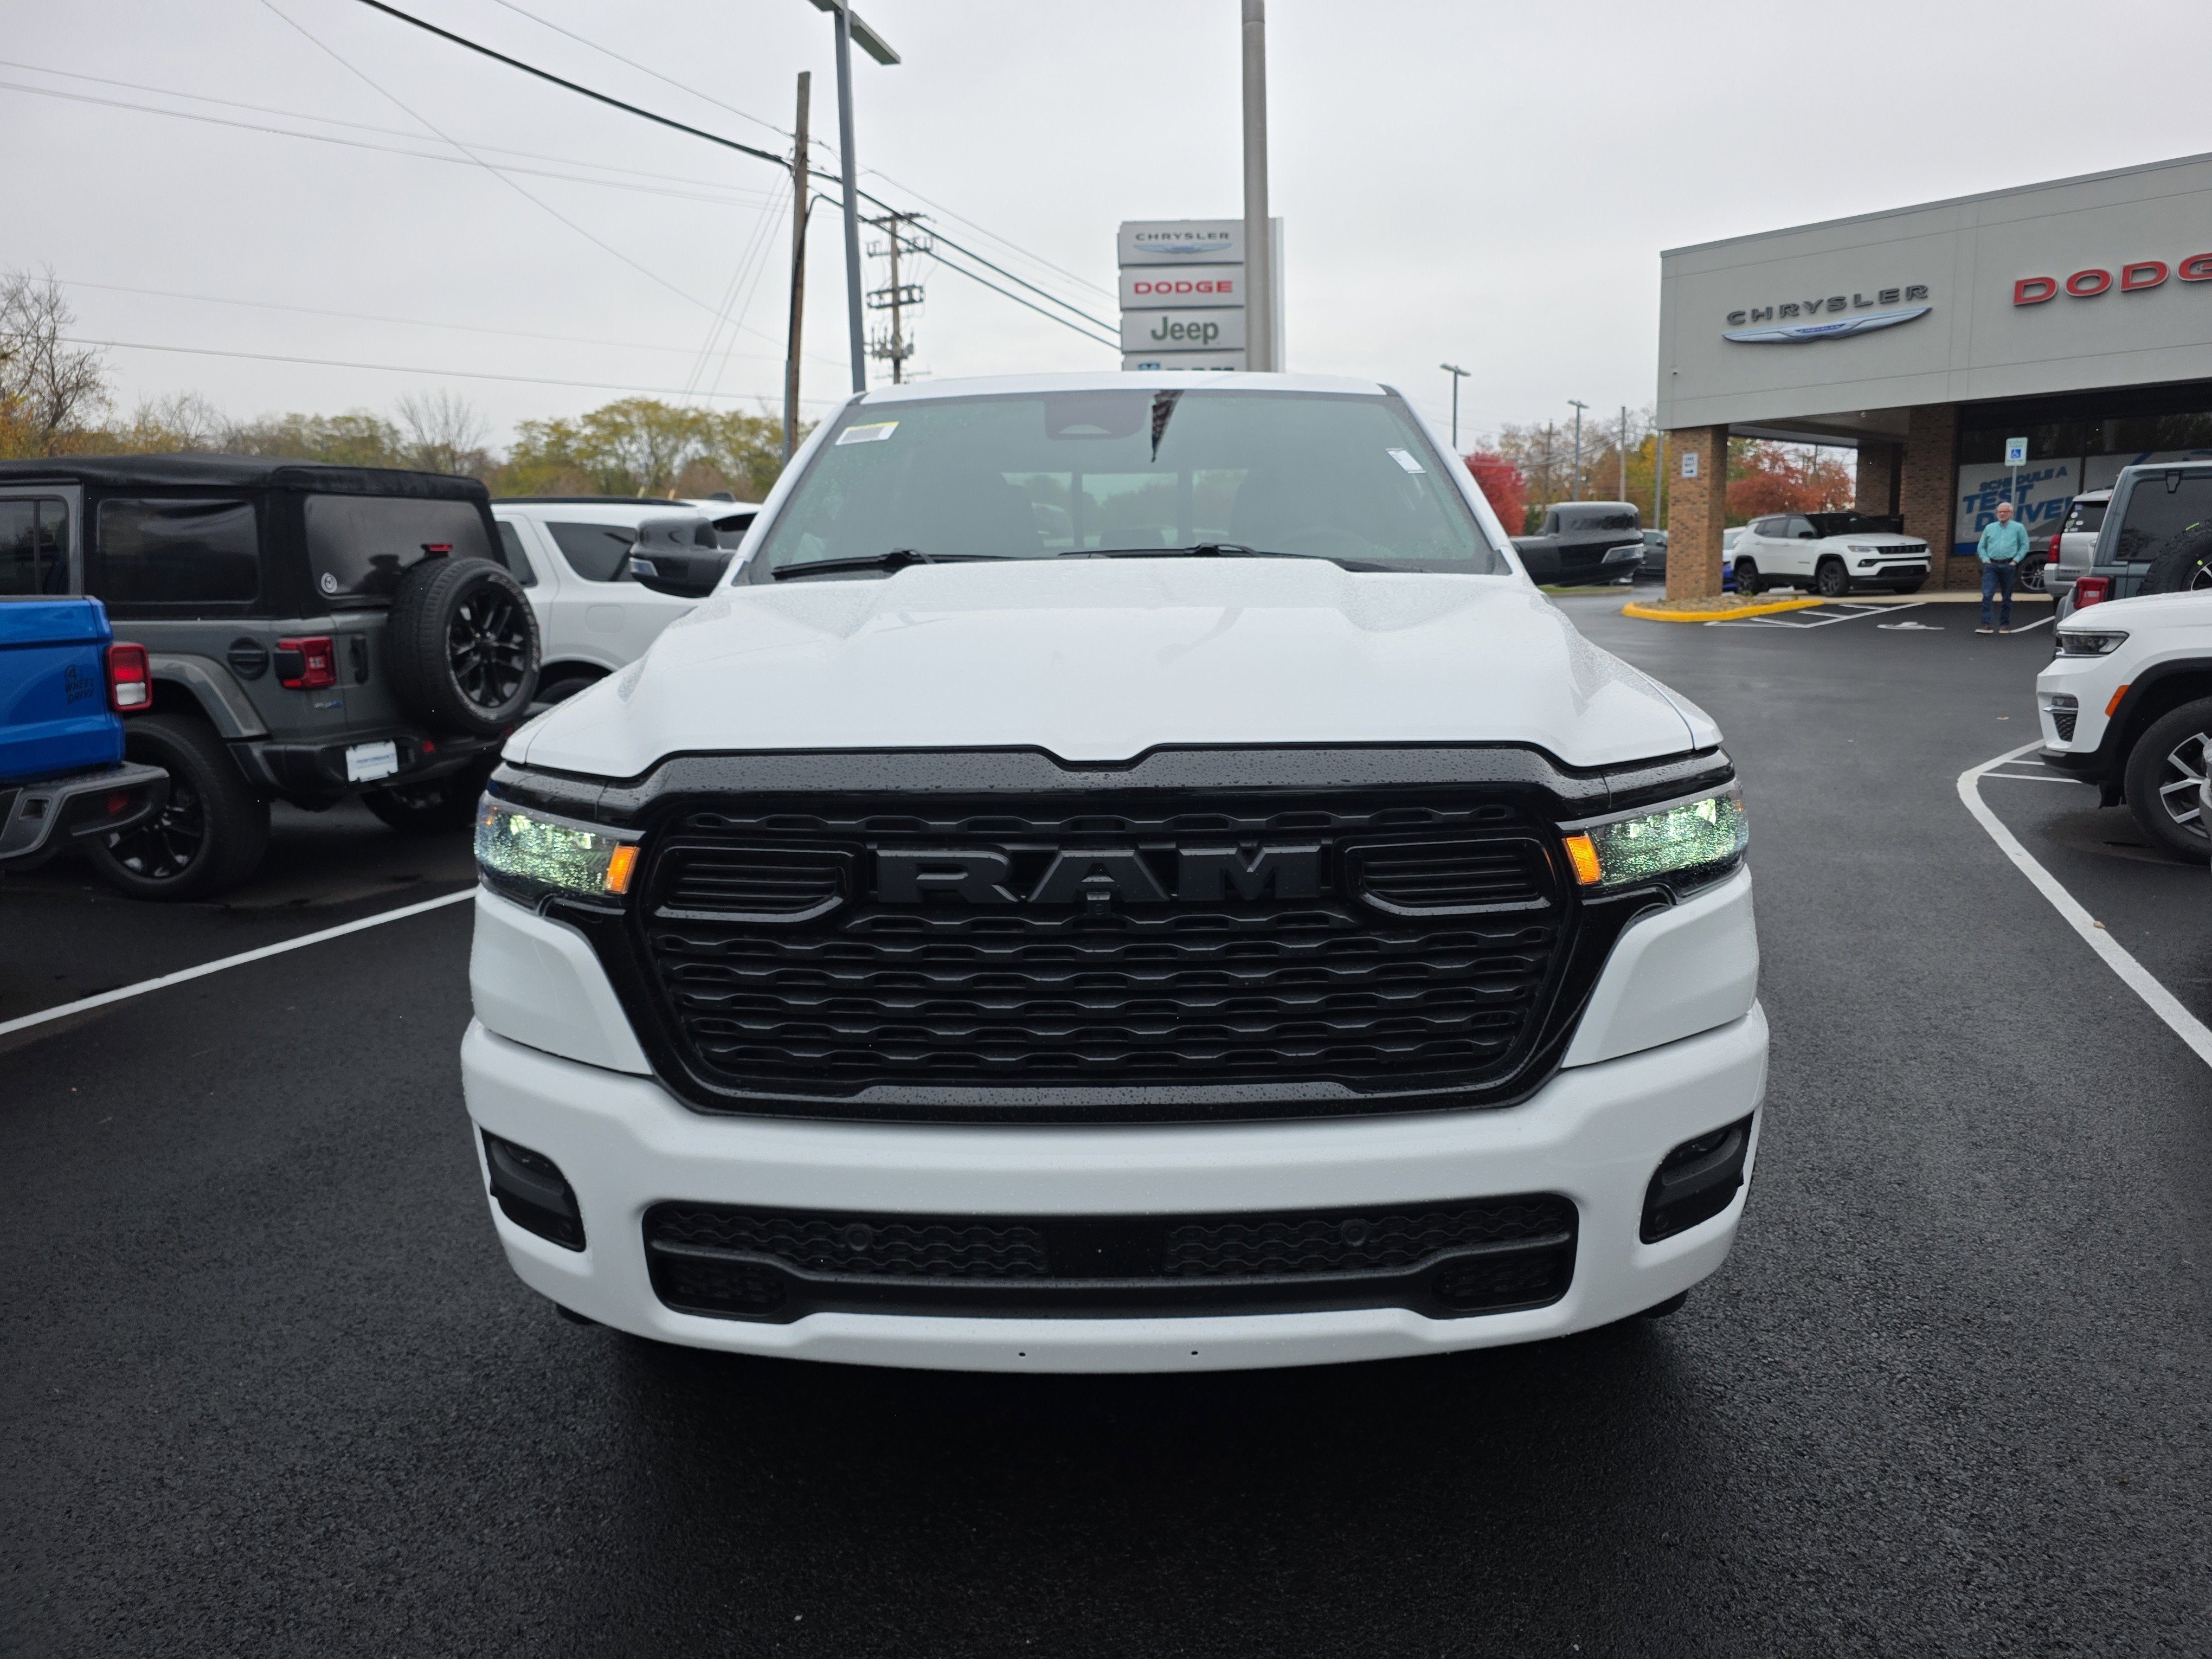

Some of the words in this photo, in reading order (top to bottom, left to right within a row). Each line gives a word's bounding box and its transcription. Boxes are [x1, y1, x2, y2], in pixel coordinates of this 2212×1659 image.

[1135, 232, 1230, 241] CHRYSLER
[1134, 280, 1233, 295] DODGE
[1726, 284, 1929, 325] CHRYSLER
[1151, 316, 1219, 345] Jeep
[1963, 484, 2035, 515] TEST
[876, 845, 1322, 903] RAM
